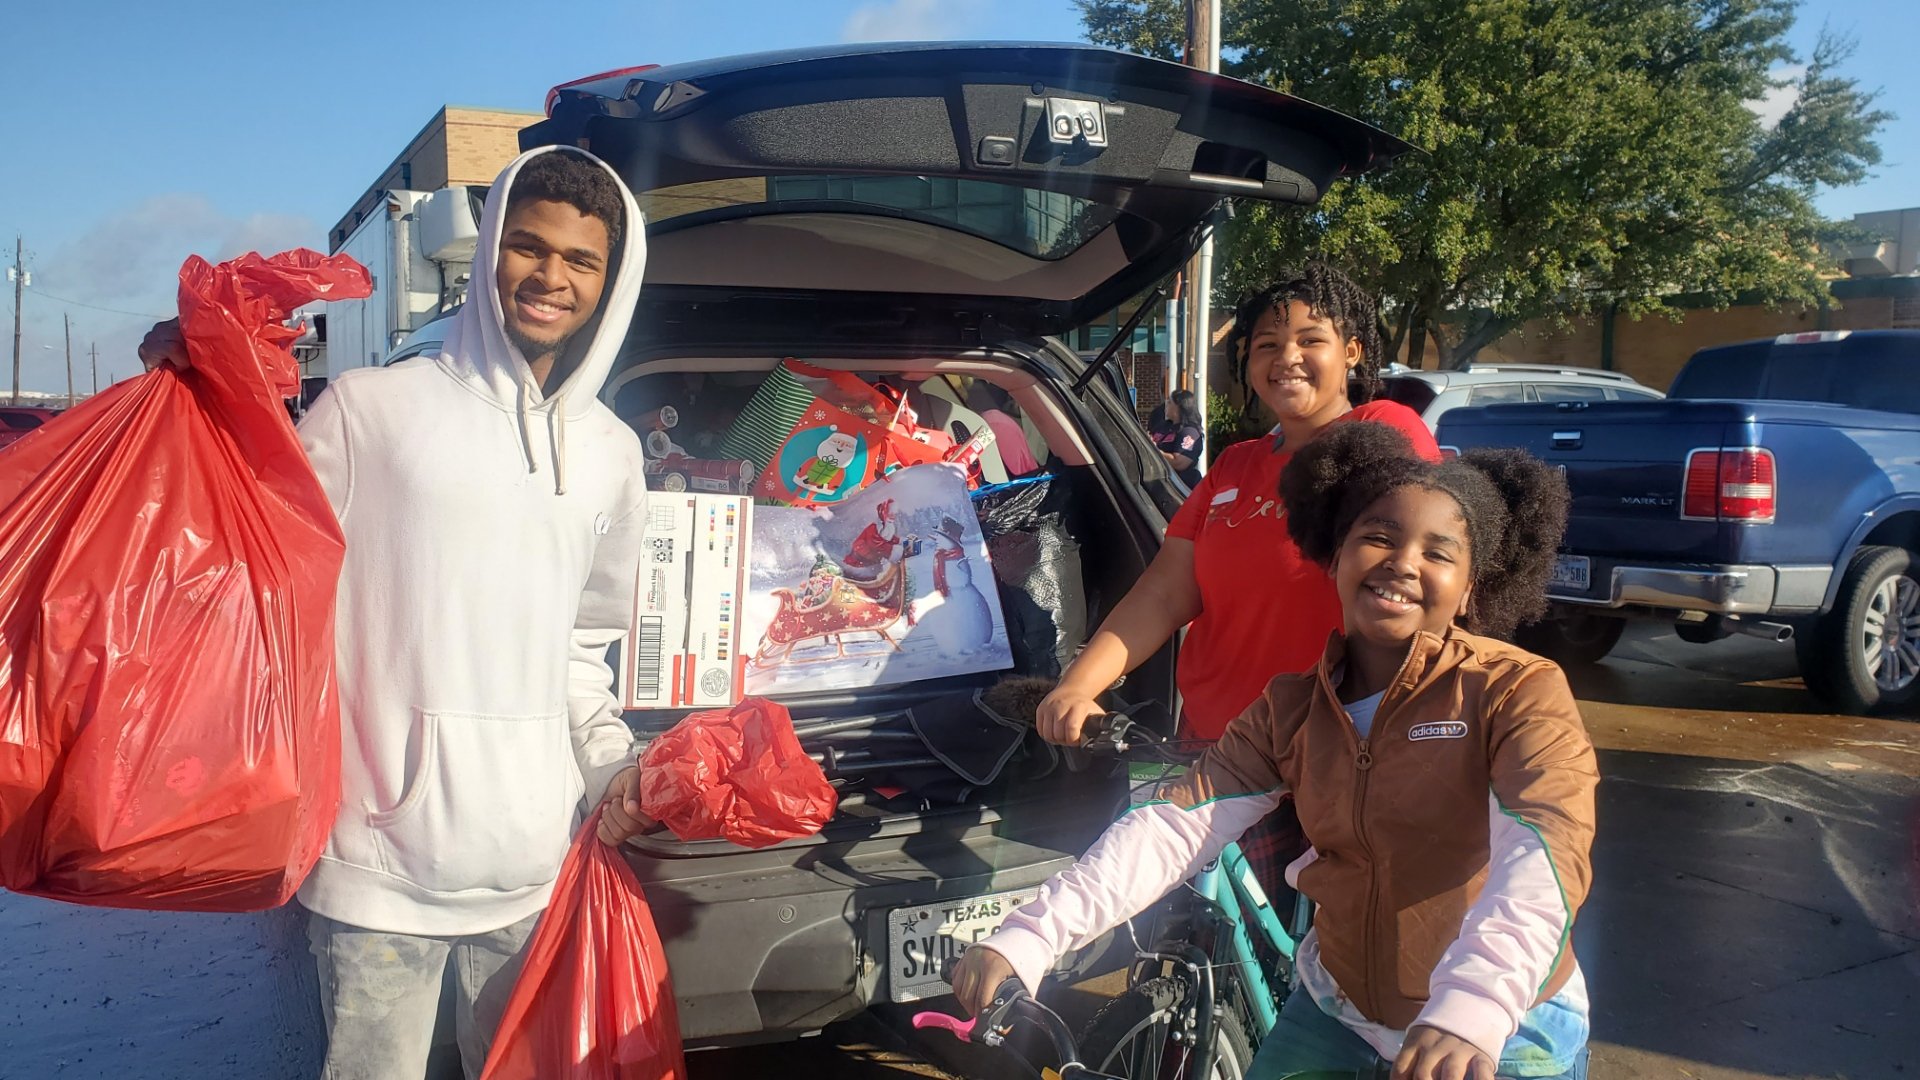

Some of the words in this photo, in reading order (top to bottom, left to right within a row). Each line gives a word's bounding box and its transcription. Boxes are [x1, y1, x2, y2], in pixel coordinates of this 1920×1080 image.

[1621, 496, 1656, 505] MARK
[1661, 498, 1674, 506] LT
[1411, 725, 1447, 738] adidas
[942, 902, 1001, 923] TEXAS
